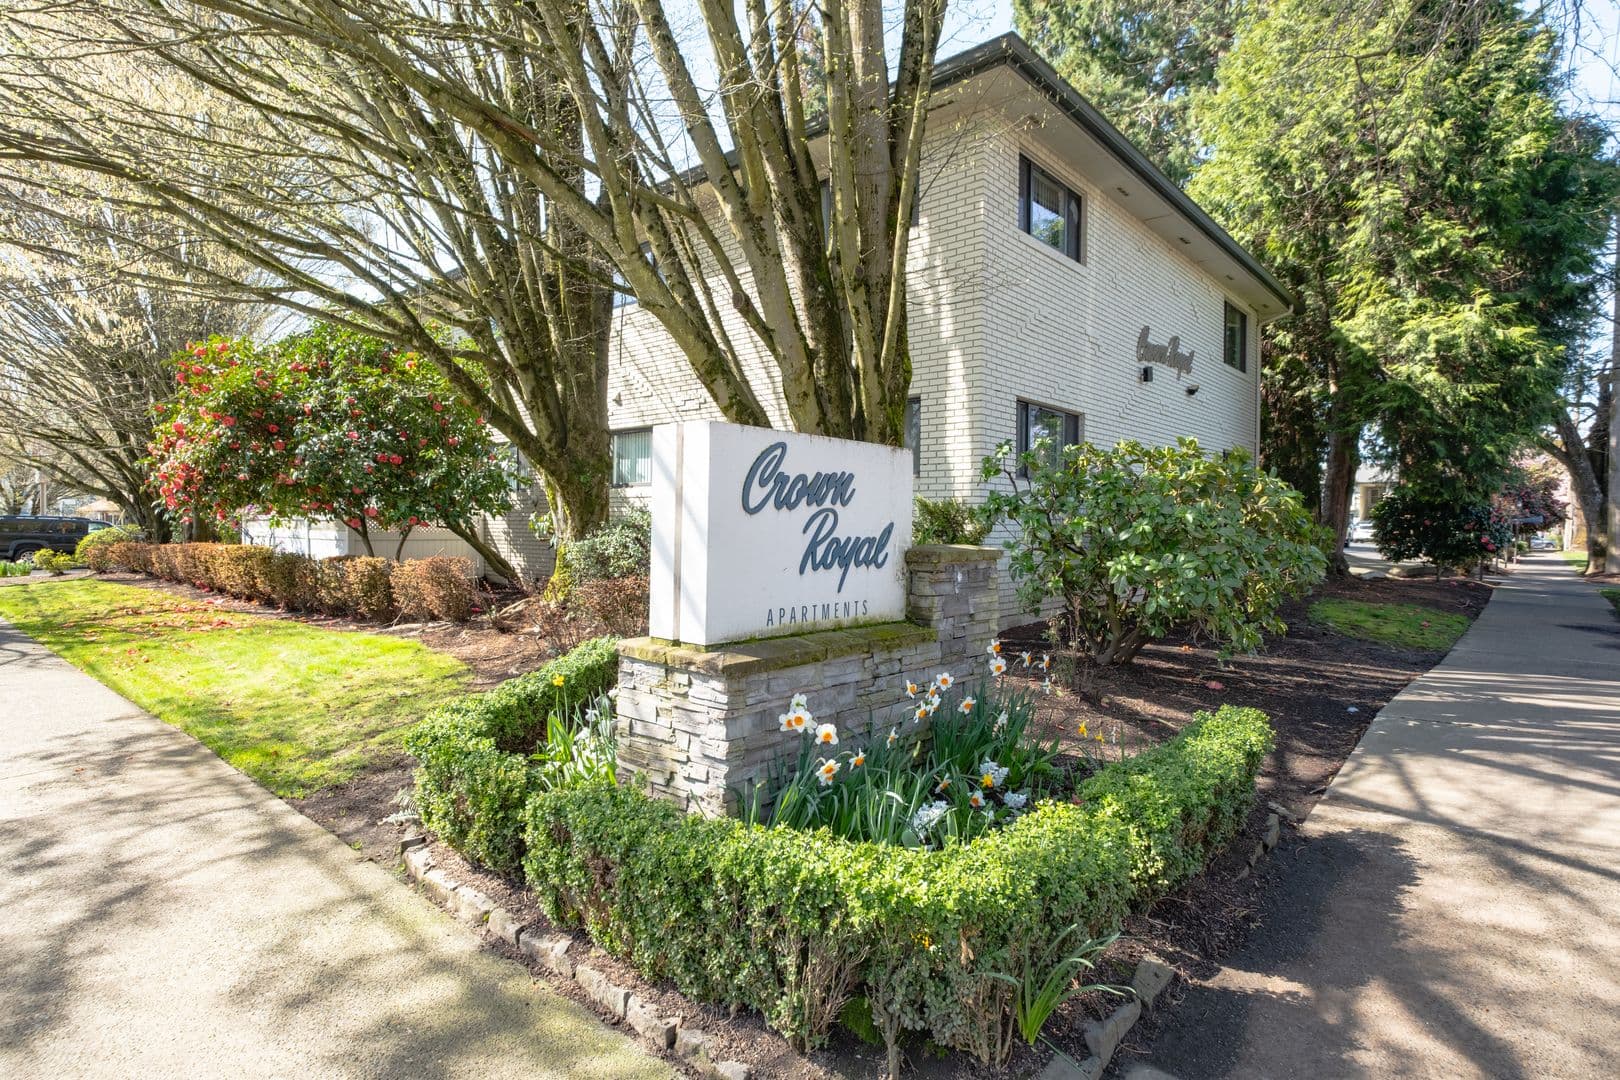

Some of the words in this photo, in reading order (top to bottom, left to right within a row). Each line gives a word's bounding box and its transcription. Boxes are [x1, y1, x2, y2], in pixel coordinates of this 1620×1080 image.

[742, 441, 855, 515] Crown
[800, 507, 894, 593] Royal
[766, 600, 868, 626] APARTMENTS
